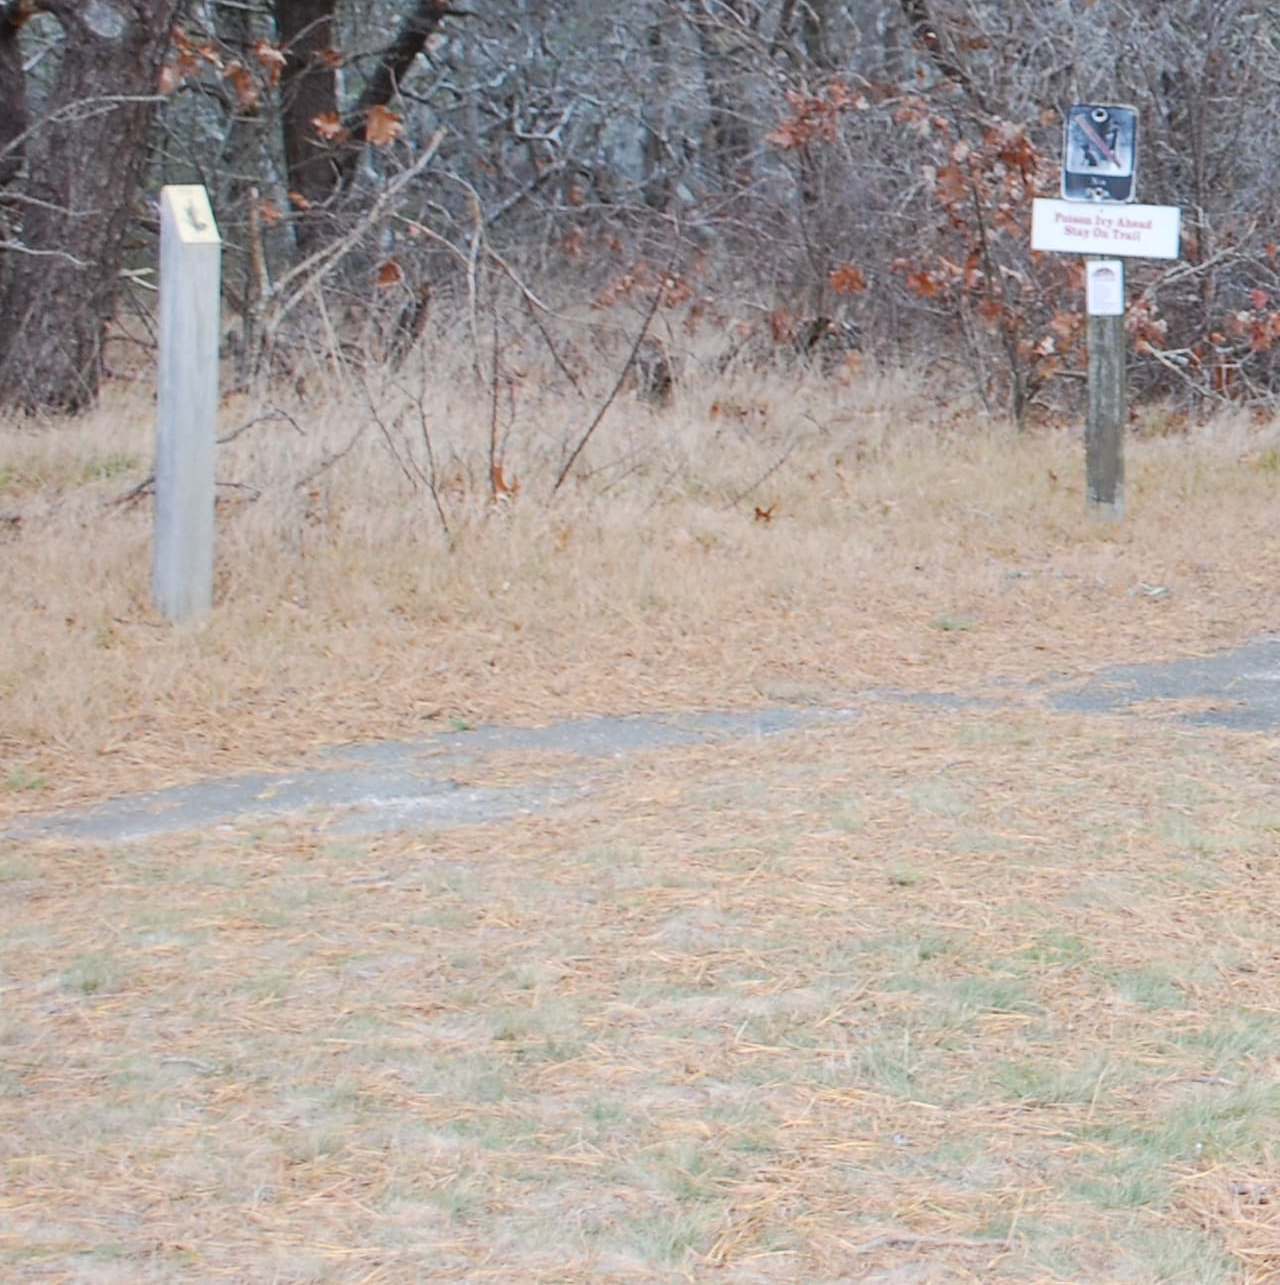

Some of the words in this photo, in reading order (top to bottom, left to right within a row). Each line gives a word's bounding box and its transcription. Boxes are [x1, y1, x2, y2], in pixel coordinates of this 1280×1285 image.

[1095, 214, 1113, 227] Ivy
[1116, 217, 1153, 229] Ahead
[1064, 225, 1089, 239] Stay
[1093, 228, 1109, 239] On
[1112, 229, 1142, 241] Trail
